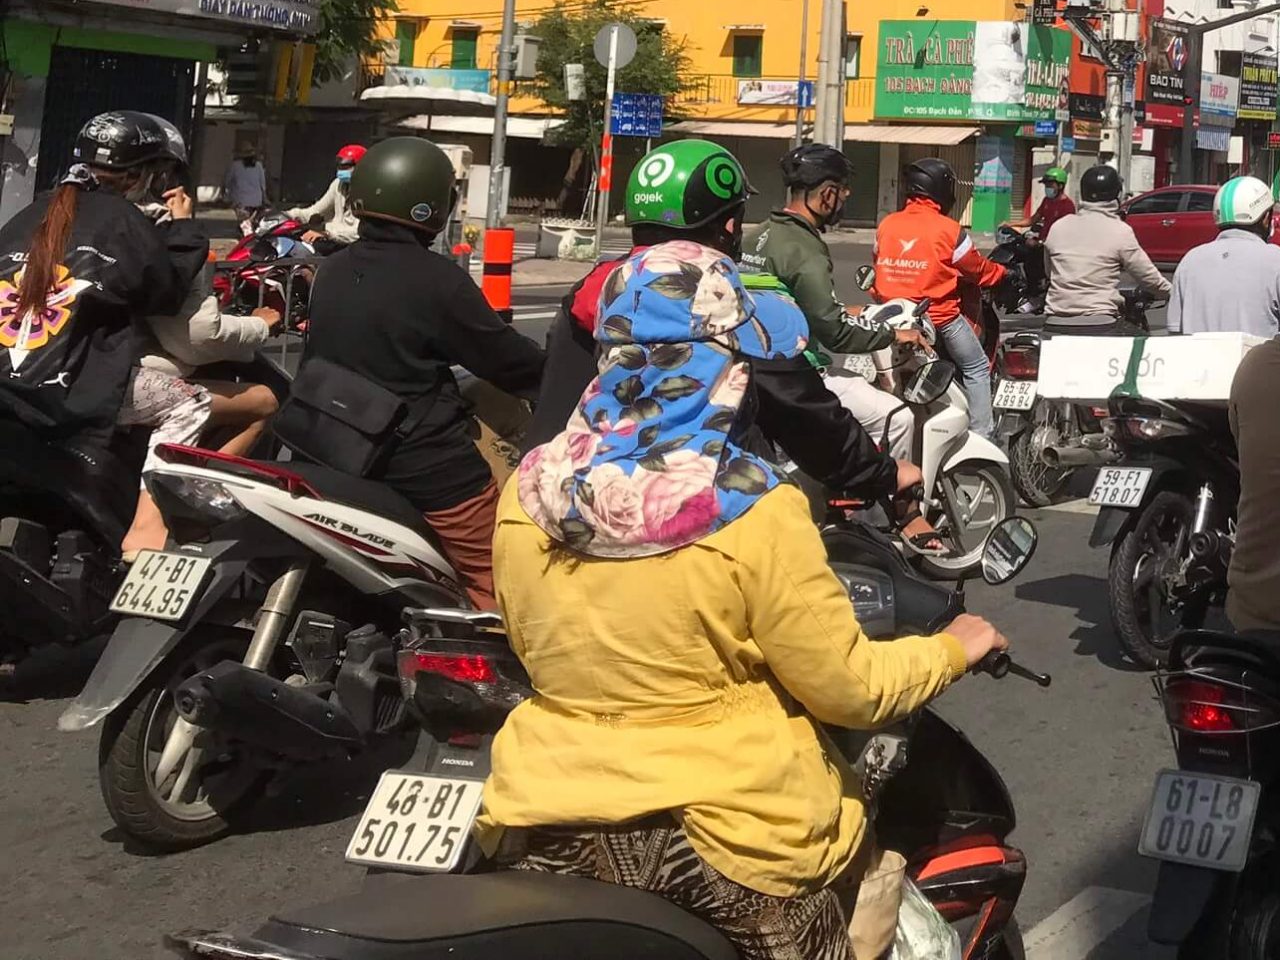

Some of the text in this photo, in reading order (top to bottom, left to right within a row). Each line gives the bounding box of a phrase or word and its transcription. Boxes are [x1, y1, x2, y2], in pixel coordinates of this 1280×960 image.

[885, 31, 915, 65] TRÀ
[924, 33, 942, 65] CÀ
[634, 191, 663, 204] gojek
[877, 257, 929, 270] LALAMOVE
[1103, 469, 1141, 485] 59-F1
[1091, 487, 1141, 505] 518.07
[303, 513, 397, 550] AIR BLADE
[139, 554, 196, 584] 47-B1
[118, 581, 188, 617] 644.95
[441, 758, 474, 766] HONDA
[1166, 779, 1244, 820] 61-L8
[355, 819, 461, 865] 501.75
[1156, 815, 1236, 860] 0007
